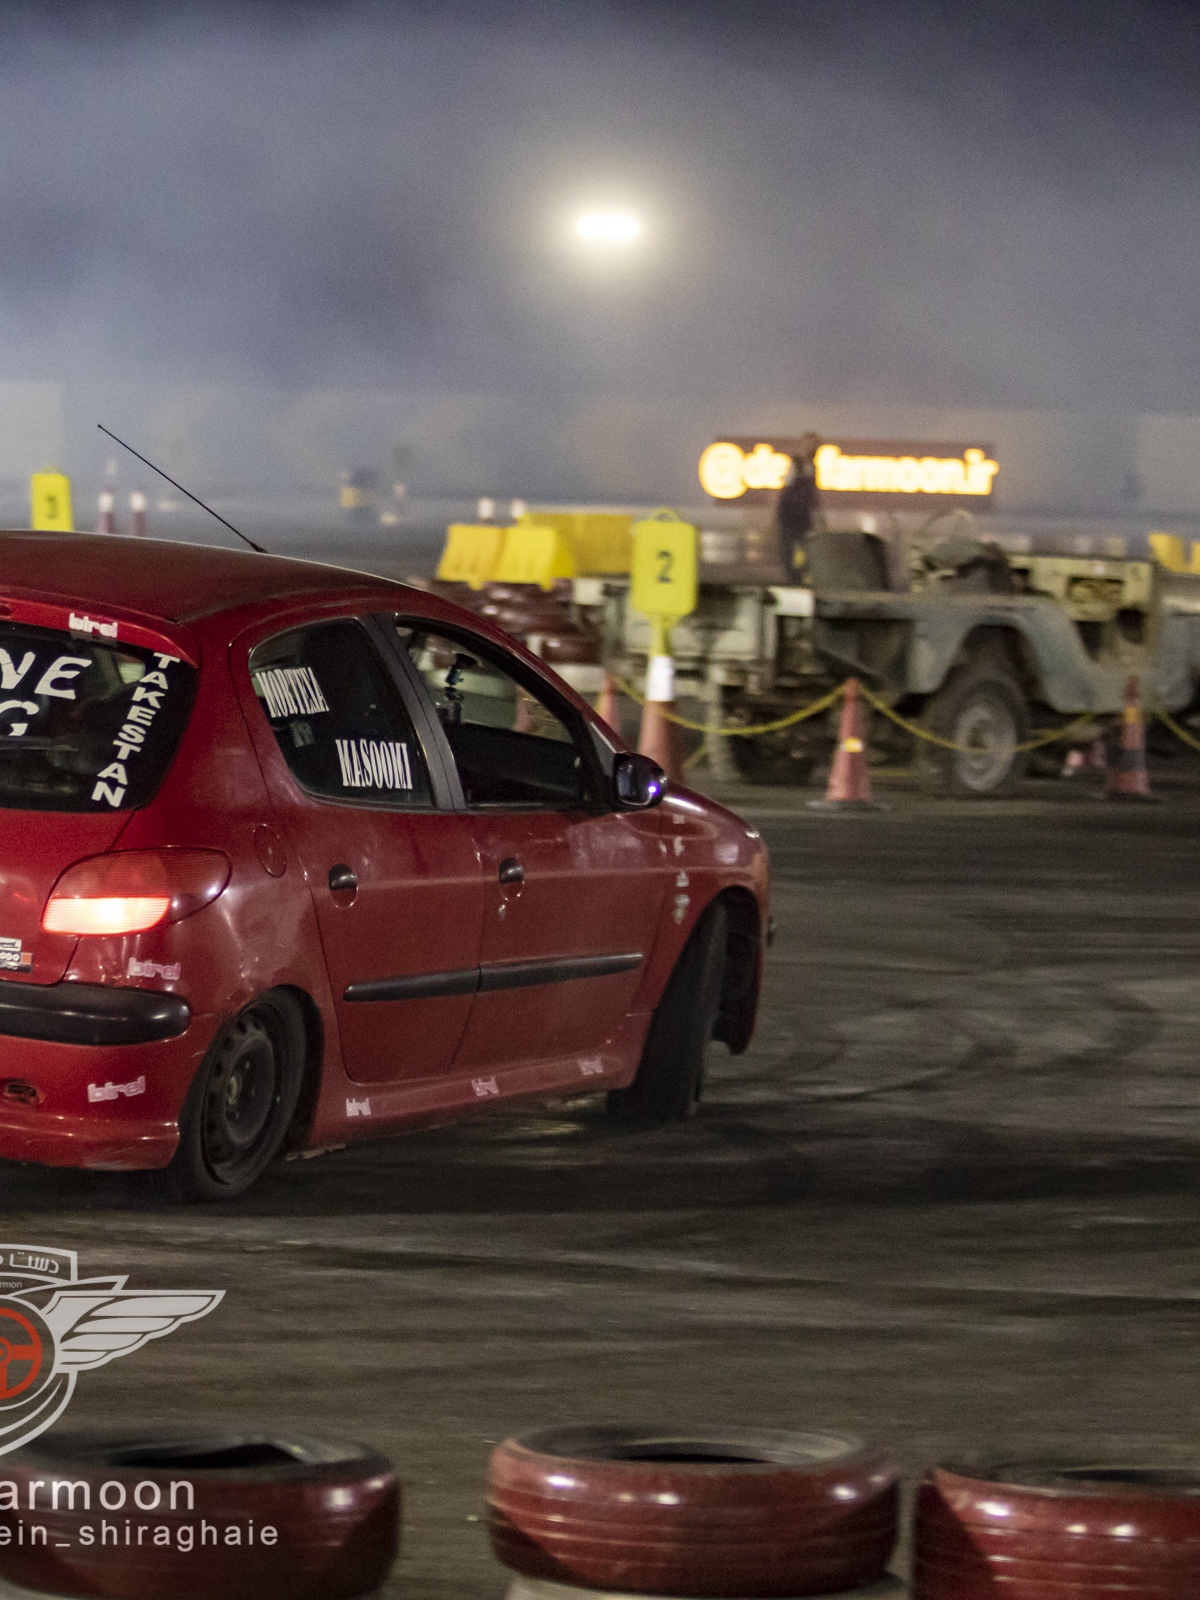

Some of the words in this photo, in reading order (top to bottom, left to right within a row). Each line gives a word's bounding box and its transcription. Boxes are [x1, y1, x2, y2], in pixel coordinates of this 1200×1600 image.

[656, 550, 674, 584] 2
[91, 652, 181, 808] TAKESTAN
[335, 738, 413, 789] MASOOMI
